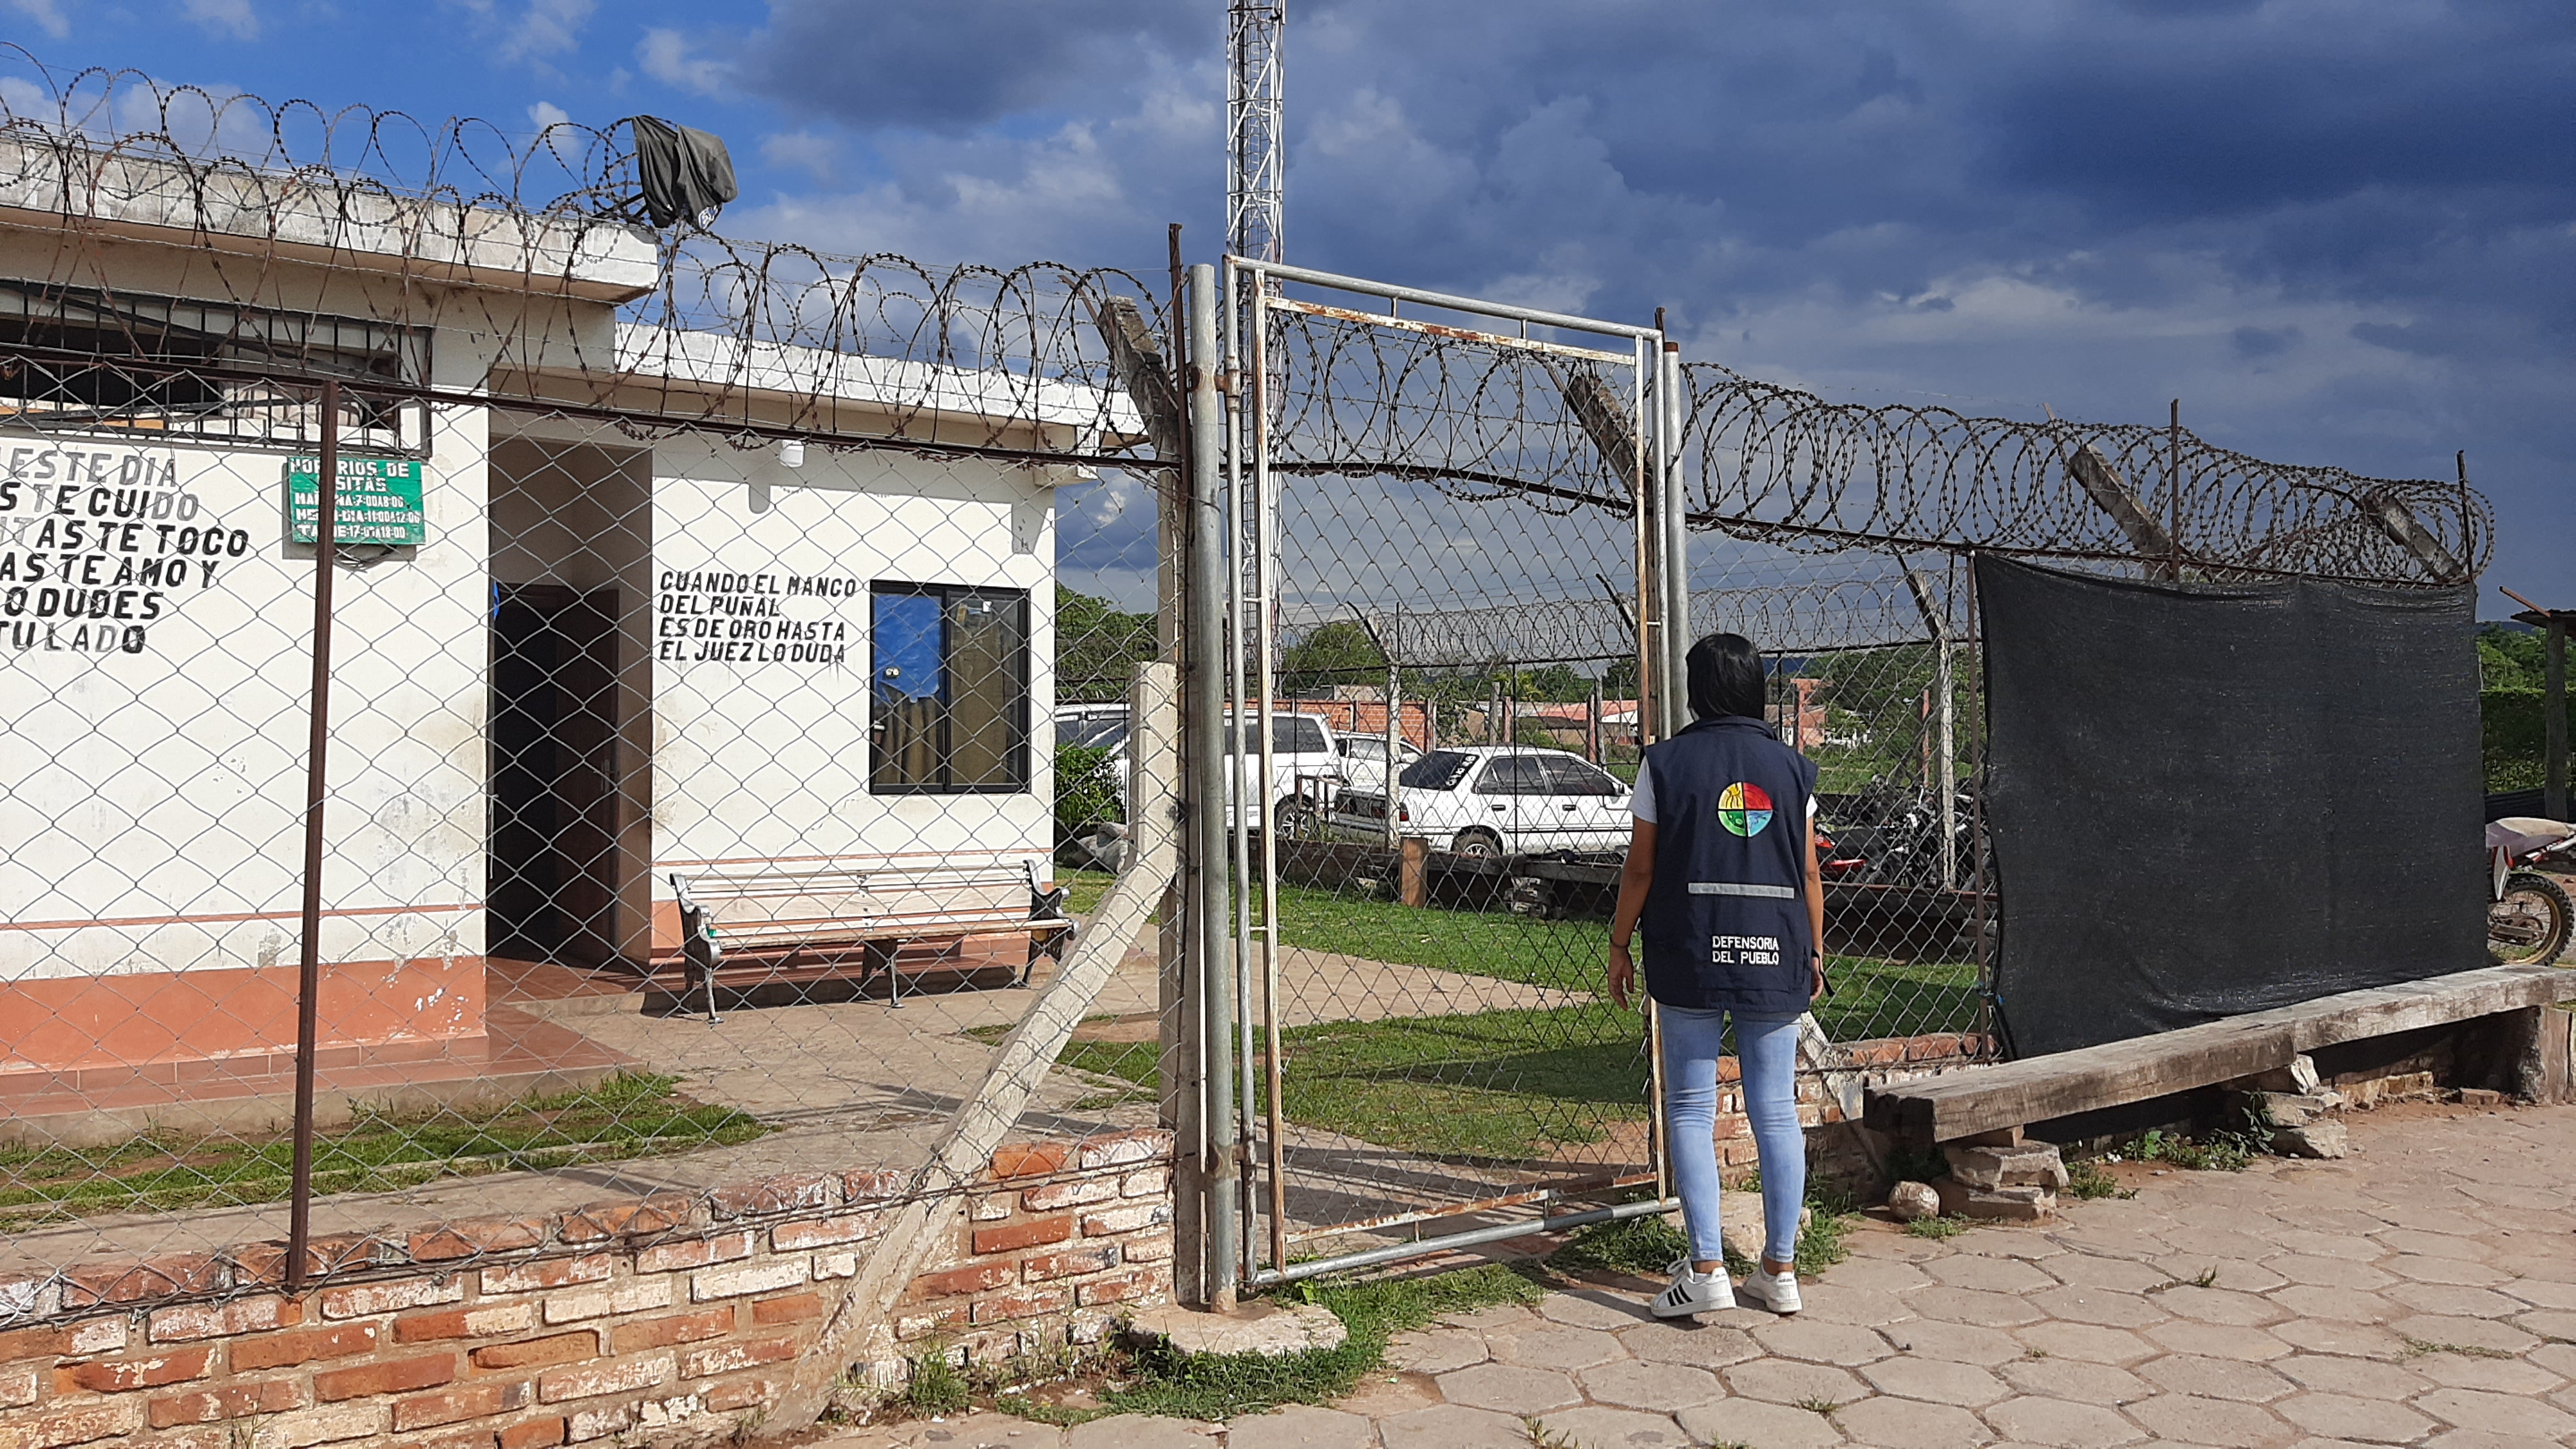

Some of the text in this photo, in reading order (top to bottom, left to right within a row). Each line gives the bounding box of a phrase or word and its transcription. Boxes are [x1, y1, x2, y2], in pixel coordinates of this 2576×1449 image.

[8, 448, 176, 488] ESTE DIA
[387, 462, 410, 478] DE
[33, 484, 80, 515] TE
[88, 488, 198, 521] CUIDO
[98, 521, 144, 553] TE
[156, 524, 249, 558] TOCO
[59, 554, 106, 584] TE
[112, 556, 187, 587] AMO
[202, 560, 220, 589] Y
[660, 571, 856, 598] CUANDO EL MANCO
[36, 588, 164, 620] DUDES
[659, 594, 781, 617] DEL PUÑAL
[44, 621, 146, 654] LADO
[659, 617, 845, 641] ES DE ORO HASTA
[659, 641, 845, 663] EL JUEZ LO DUDA
[1712, 935, 1779, 951] DEFENSORIA
[1712, 951, 1779, 965] DEL PUEBLO
